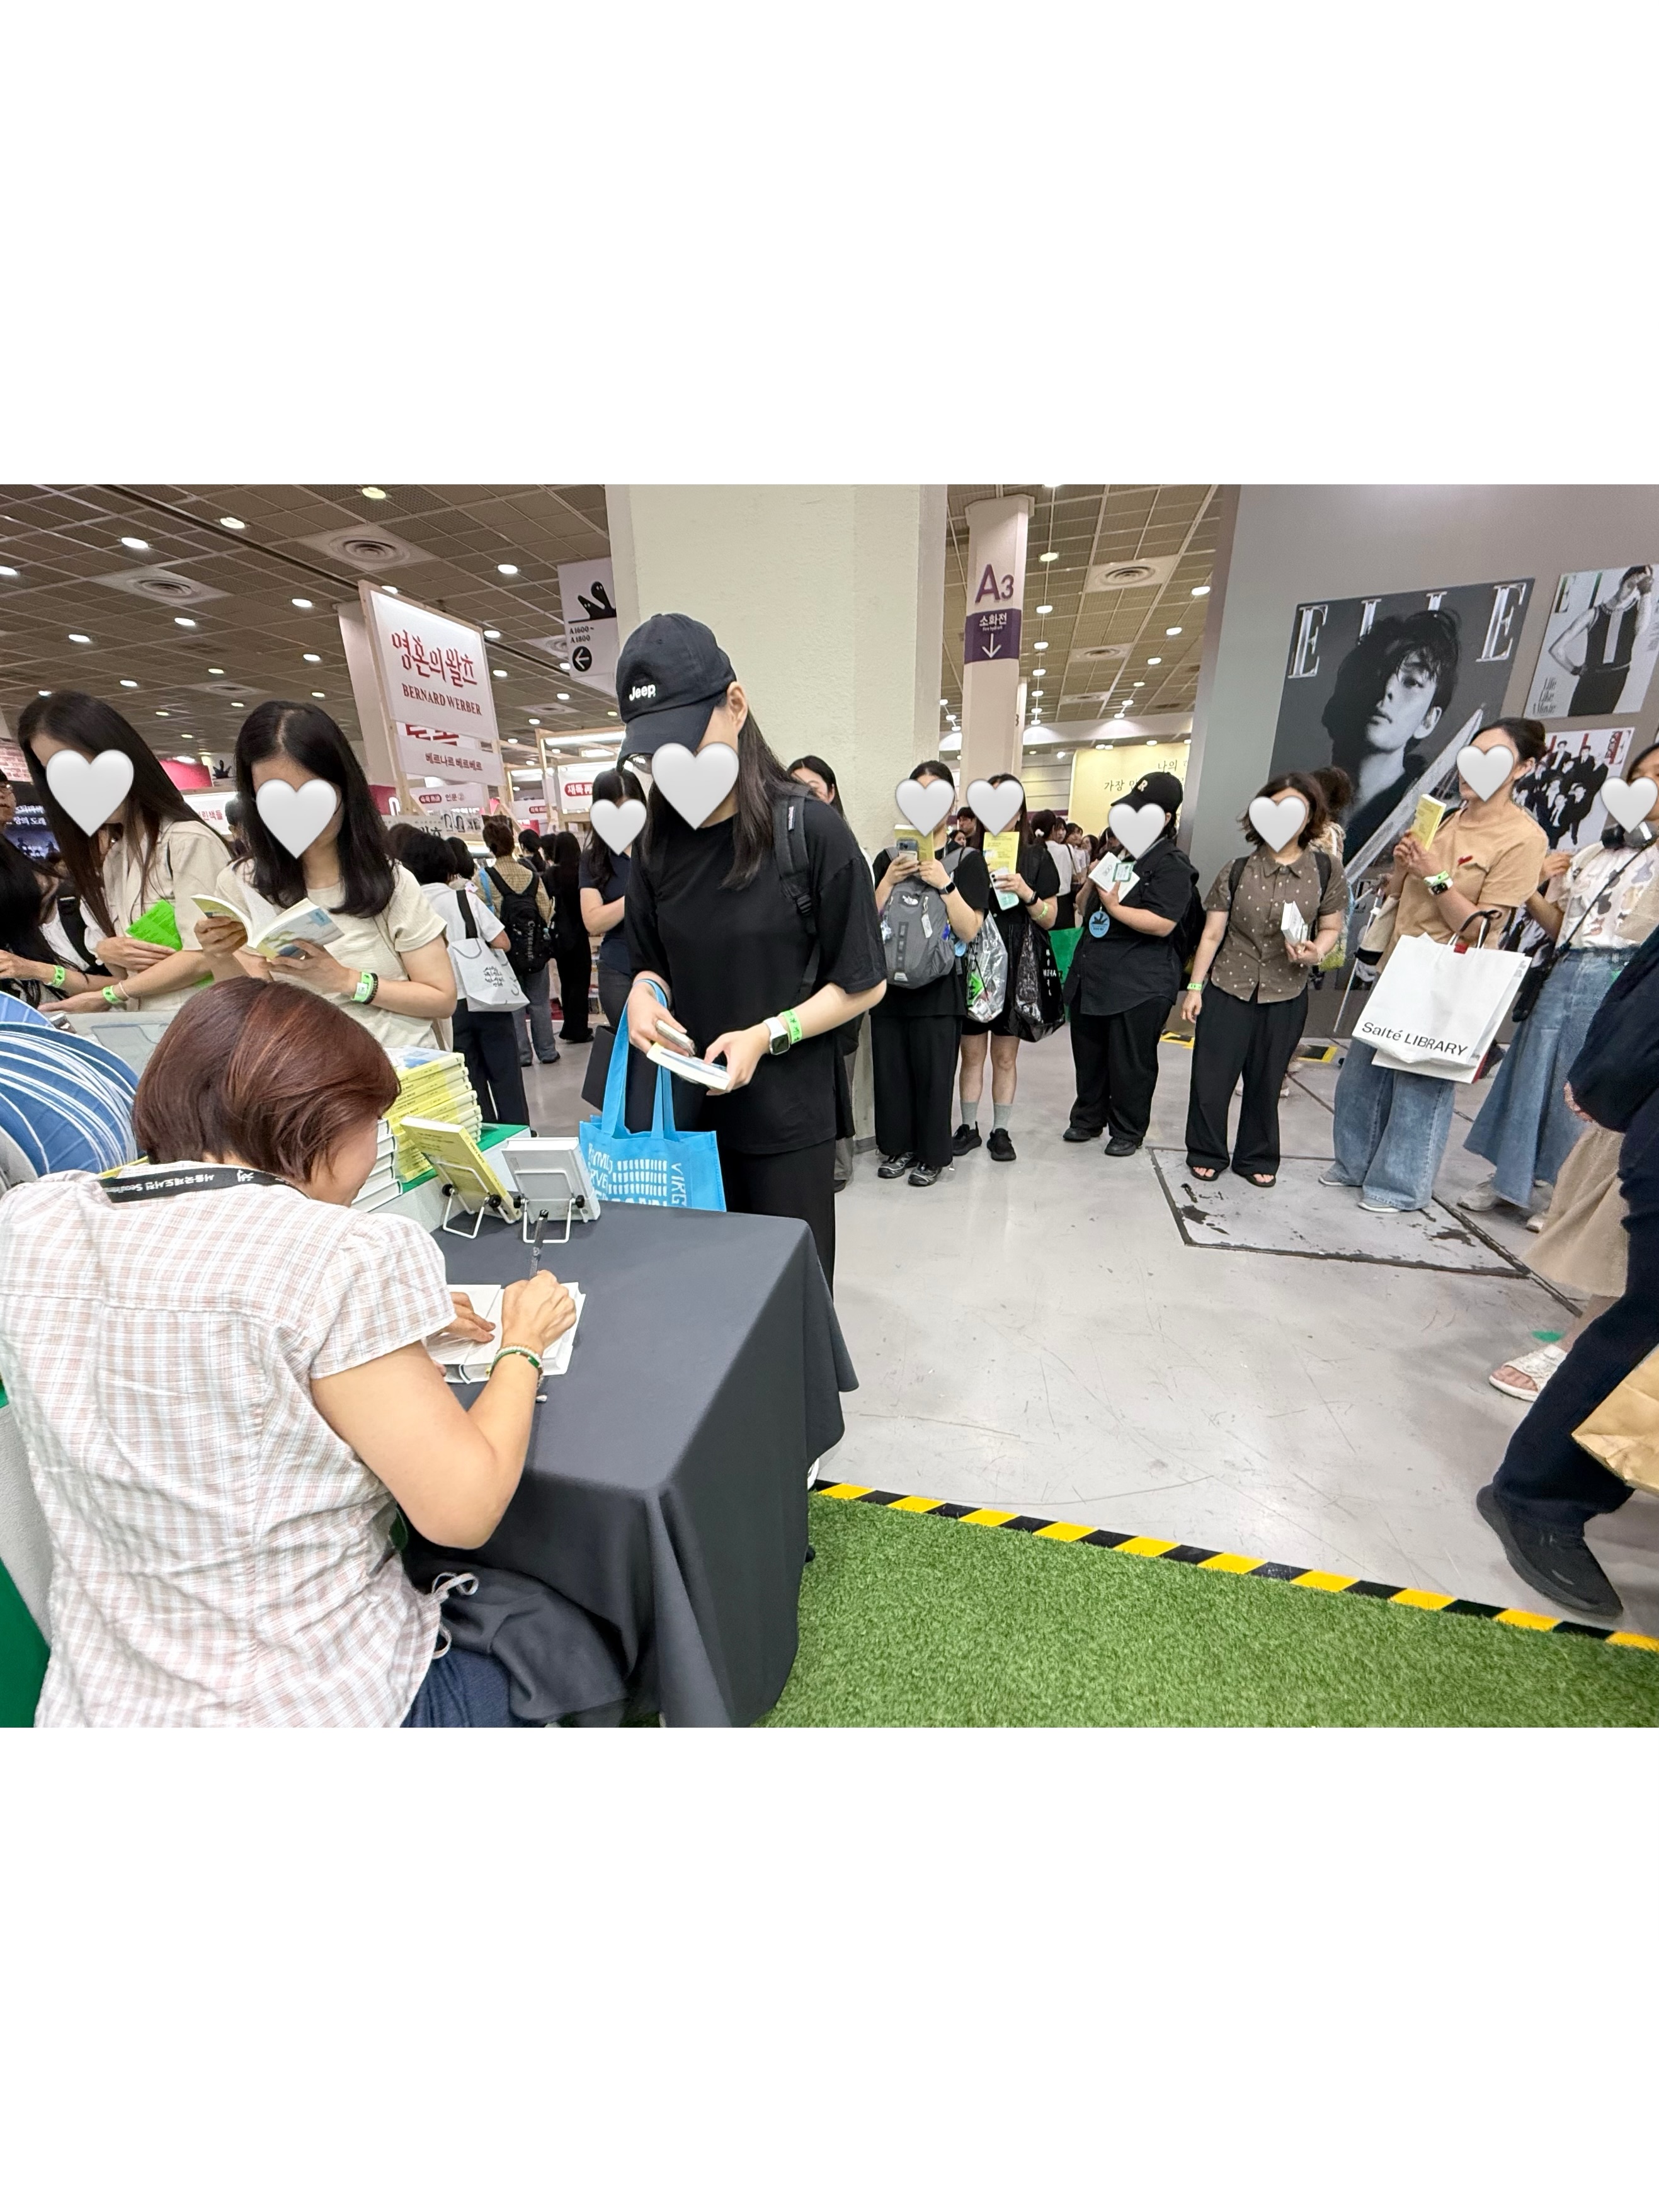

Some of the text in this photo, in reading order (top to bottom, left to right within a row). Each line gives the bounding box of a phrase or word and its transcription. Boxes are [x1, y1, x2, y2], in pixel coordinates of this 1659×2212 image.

[974, 564, 1014, 603] A3
[979, 612, 1006, 627] 소화전
[571, 635, 591, 644] A1800
[391, 629, 477, 688] 영혼의 왈츠
[1543, 677, 1557, 690] Life
[402, 683, 482, 715] BERNARD WERBER
[629, 684, 656, 701] Jeep
[425, 752, 482, 771] 베르나르 베르베르
[1158, 760, 1178, 773] 나의
[1104, 780, 1124, 792] 가장
[198, 810, 222, 821] 린책들
[1362, 1022, 1468, 1056] Salté LIBRARY
[145, 1173, 215, 1191] 서울국제도서전
